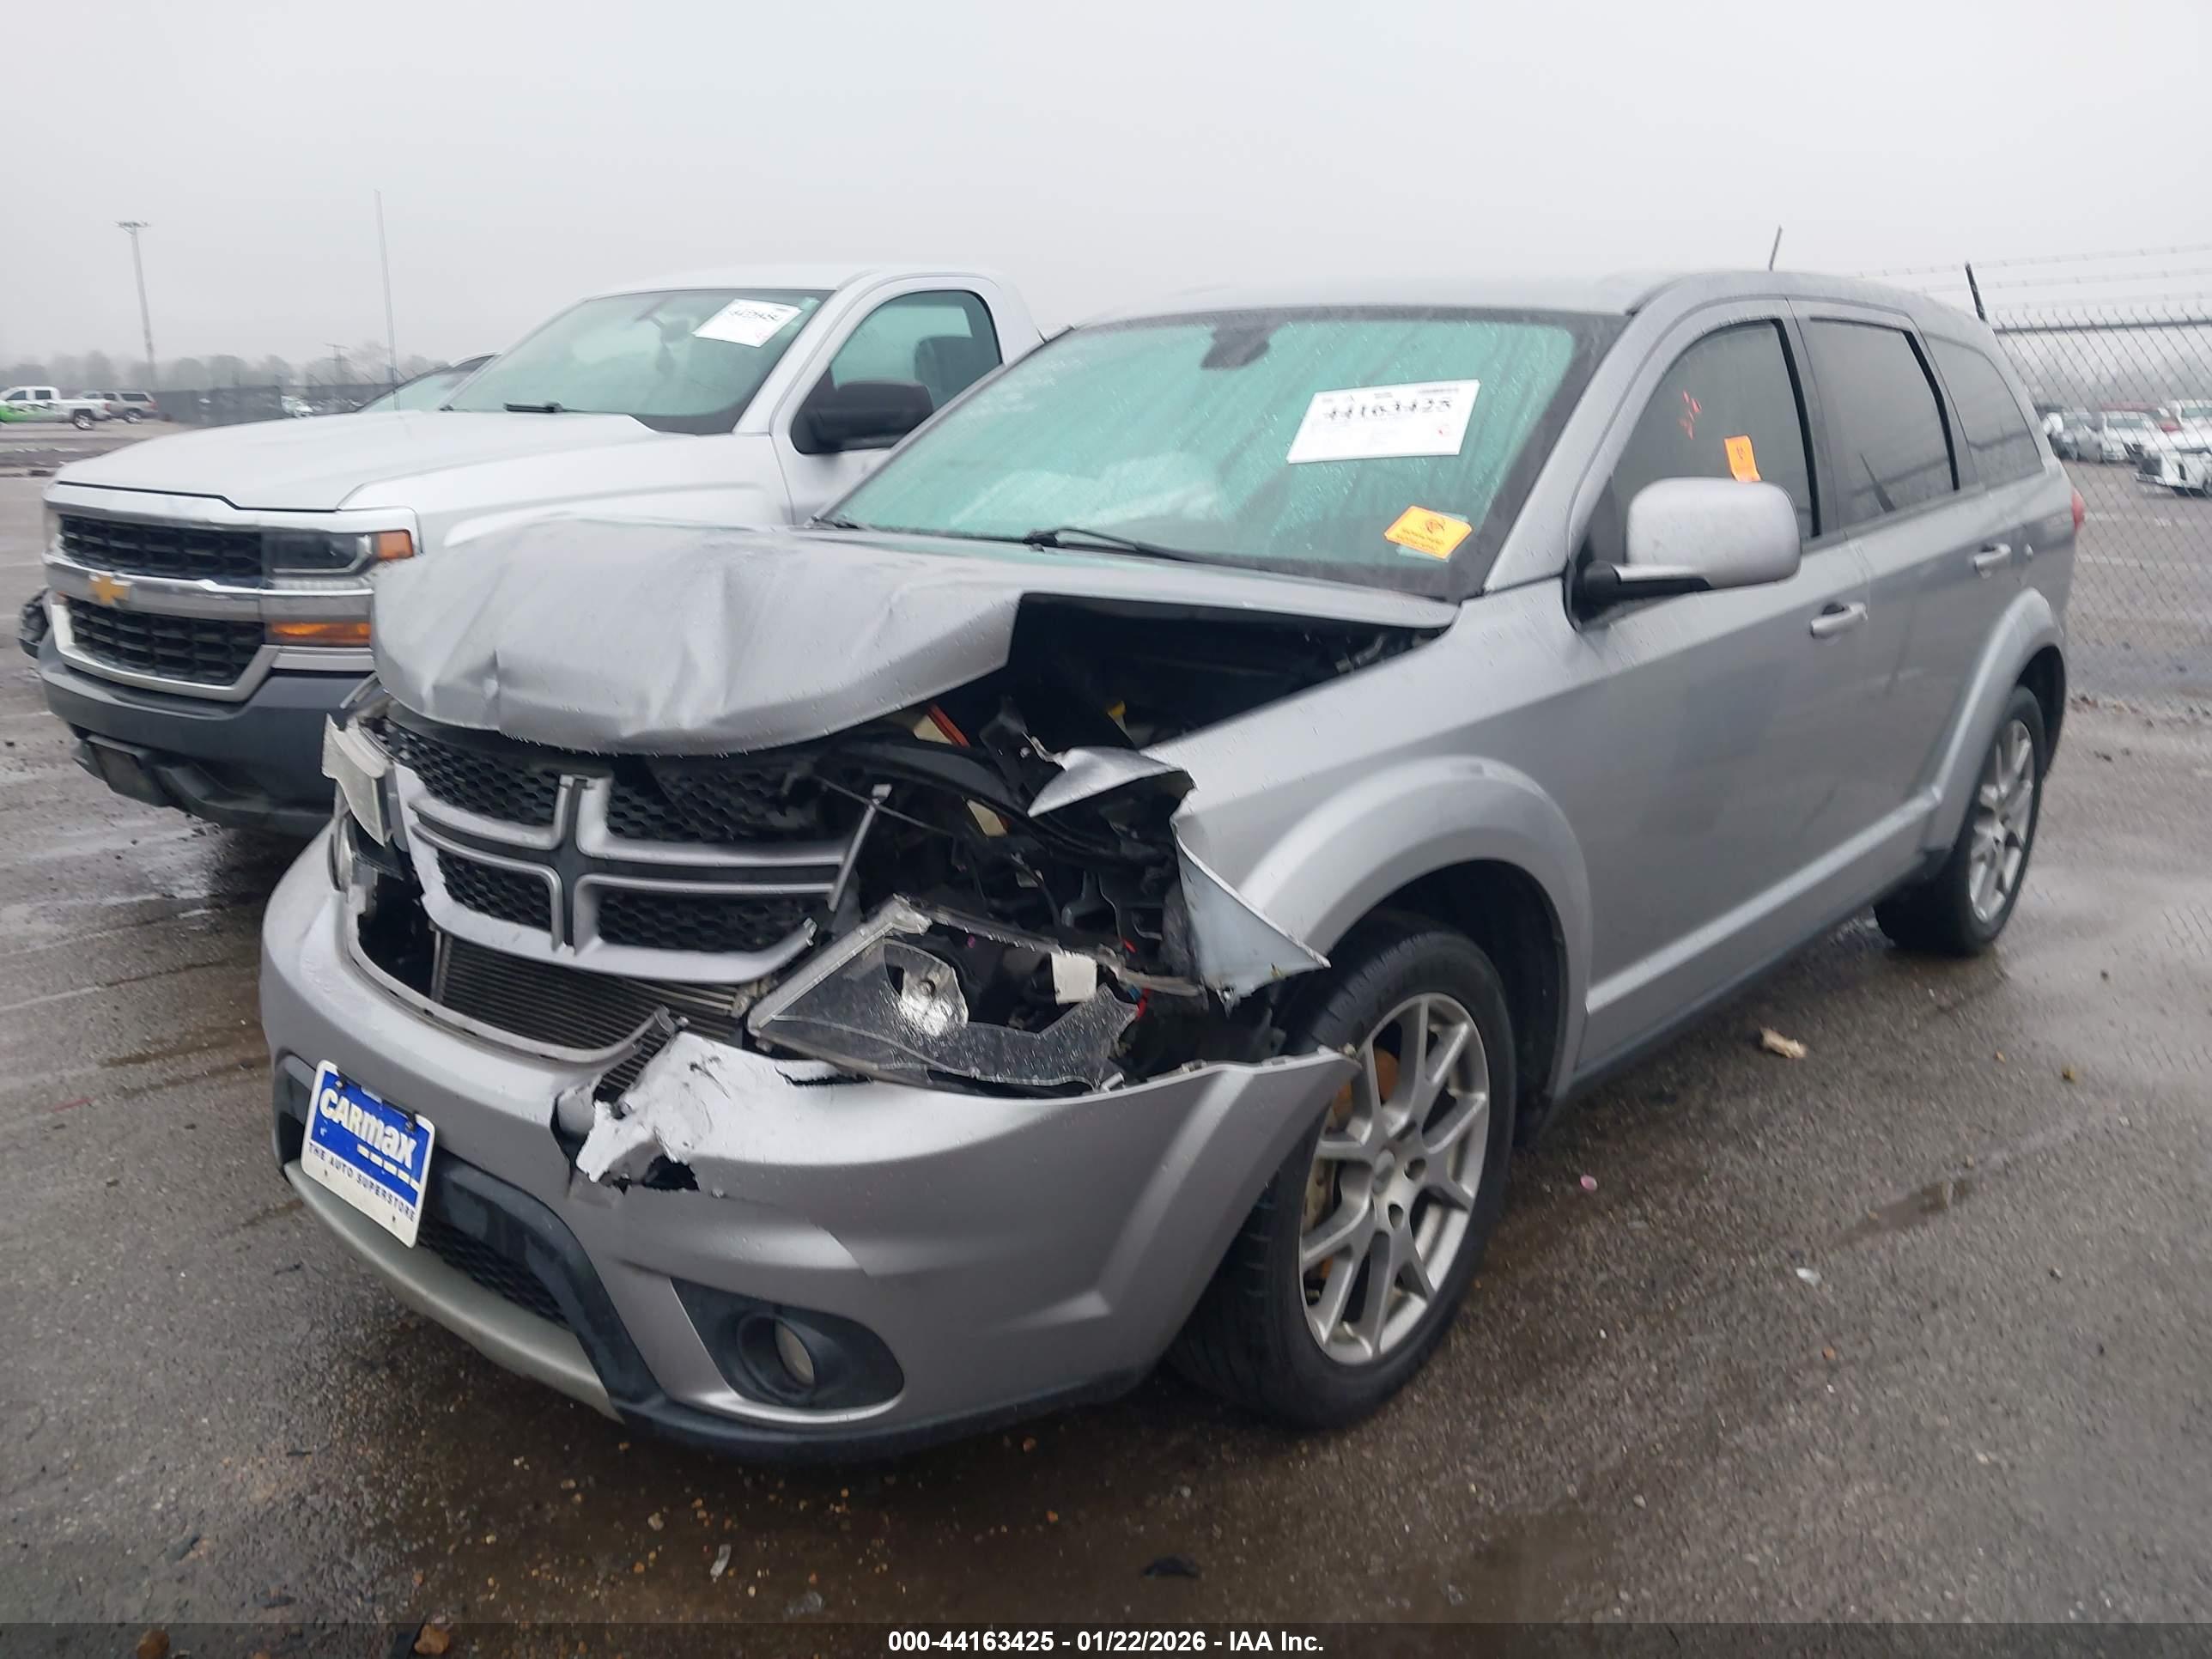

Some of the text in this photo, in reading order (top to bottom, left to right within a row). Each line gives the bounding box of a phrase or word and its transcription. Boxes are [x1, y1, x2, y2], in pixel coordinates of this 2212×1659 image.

[309, 1143, 416, 1222] THE AUTO SUPERSTORE
